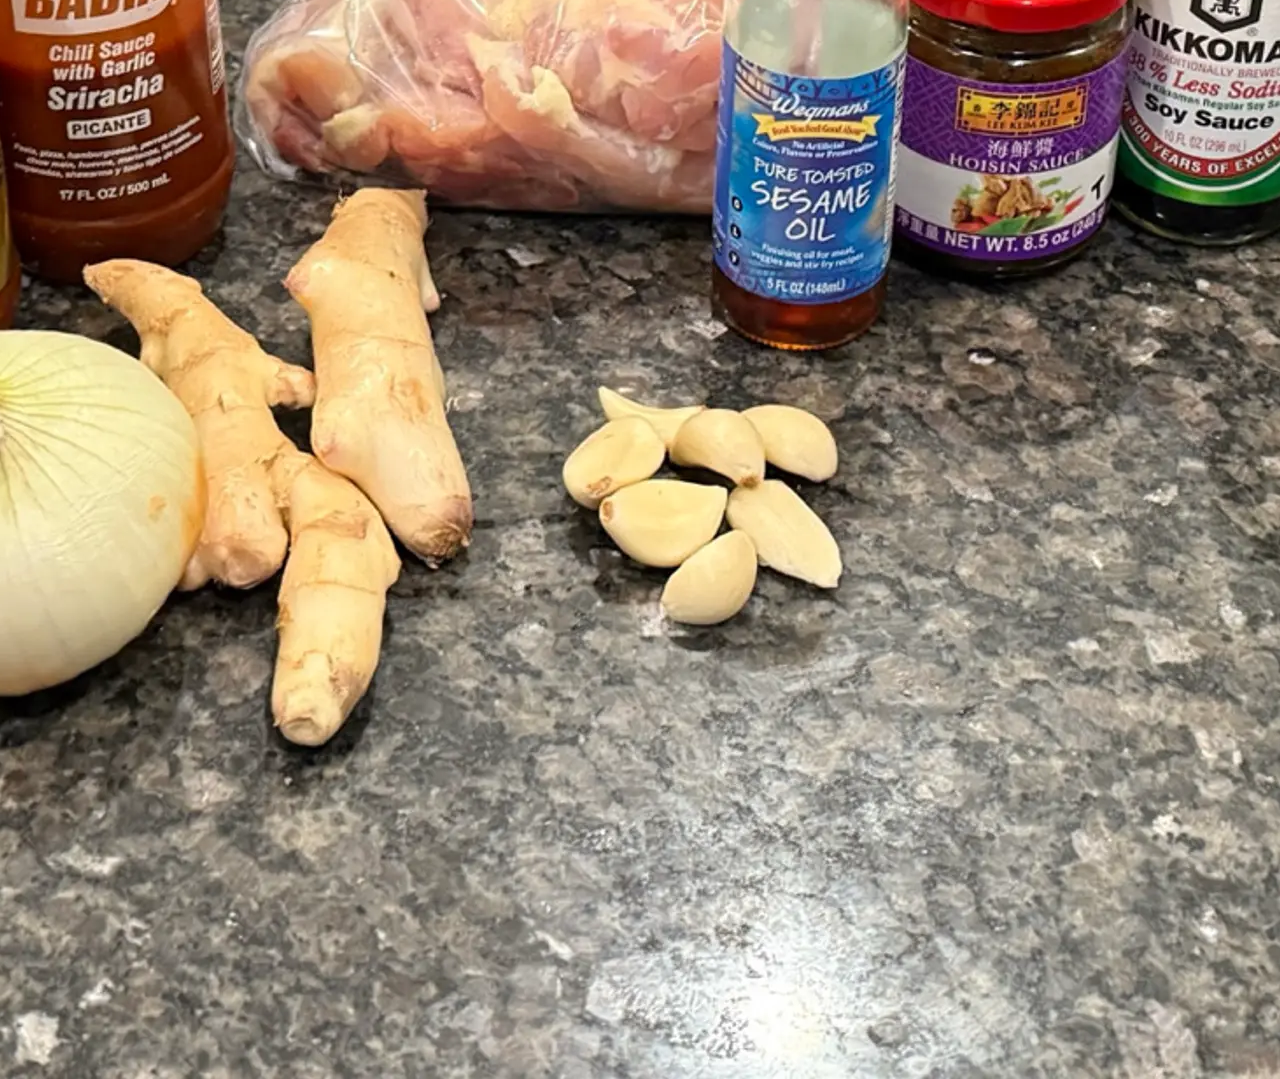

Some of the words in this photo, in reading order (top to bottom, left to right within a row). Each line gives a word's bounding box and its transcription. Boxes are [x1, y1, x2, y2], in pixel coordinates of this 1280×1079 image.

[48, 43, 94, 62] Chili
[99, 32, 156, 58] Sauce
[53, 64, 96, 81] with
[101, 51, 156, 79] Garlic
[1151, 48, 1234, 77] TRADITIONALLY
[47, 73, 165, 111] Sriracha
[1150, 61, 1168, 83] %
[1173, 70, 1220, 97] Less
[771, 92, 870, 123] Wegmans
[991, 98, 1061, 120] 李錦記
[1144, 92, 1188, 125] Soy
[1196, 110, 1275, 131] Sauce
[1153, 83, 1200, 106] Kikkoman
[1203, 99, 1244, 112] Regular
[1246, 101, 1265, 112] Soy
[71, 112, 147, 136] PICANTE
[986, 120, 1005, 130] LEE
[1009, 120, 1035, 130] KUM
[1036, 118, 1059, 128] KEE
[987, 137, 1054, 158] 海鮮醬
[1129, 114, 1151, 142] 300
[1153, 141, 1201, 173] YEARS
[1208, 161, 1229, 175] OF
[1176, 133, 1187, 147] FL
[1189, 135, 1203, 151] OZ
[753, 156, 799, 183] PURE
[802, 162, 875, 185] TOASTED
[949, 151, 1021, 174] HOISIN
[1028, 148, 1085, 173] SAUCE
[59, 189, 74, 201] 17
[77, 189, 95, 201] FL
[97, 187, 118, 200] OZ
[127, 180, 150, 196] 500
[151, 172, 172, 189] mL
[751, 179, 871, 215] SESAME
[1091, 174, 1106, 201] T
[785, 217, 836, 242] OIL
[944, 230, 983, 251] NET
[985, 236, 1018, 253] WT.
[1022, 234, 1049, 251] 8.5
[1051, 230, 1069, 247] oz
[761, 242, 802, 260] Finishing
[804, 249, 817, 259] oil
[818, 250, 830, 259] for
[784, 257, 802, 268] and
[804, 258, 819, 268] stir
[820, 257, 834, 269] fry
[835, 252, 864, 268] recipes
[766, 278, 774, 289] 5
[775, 280, 788, 293] FL
[790, 282, 805, 294] OZ
